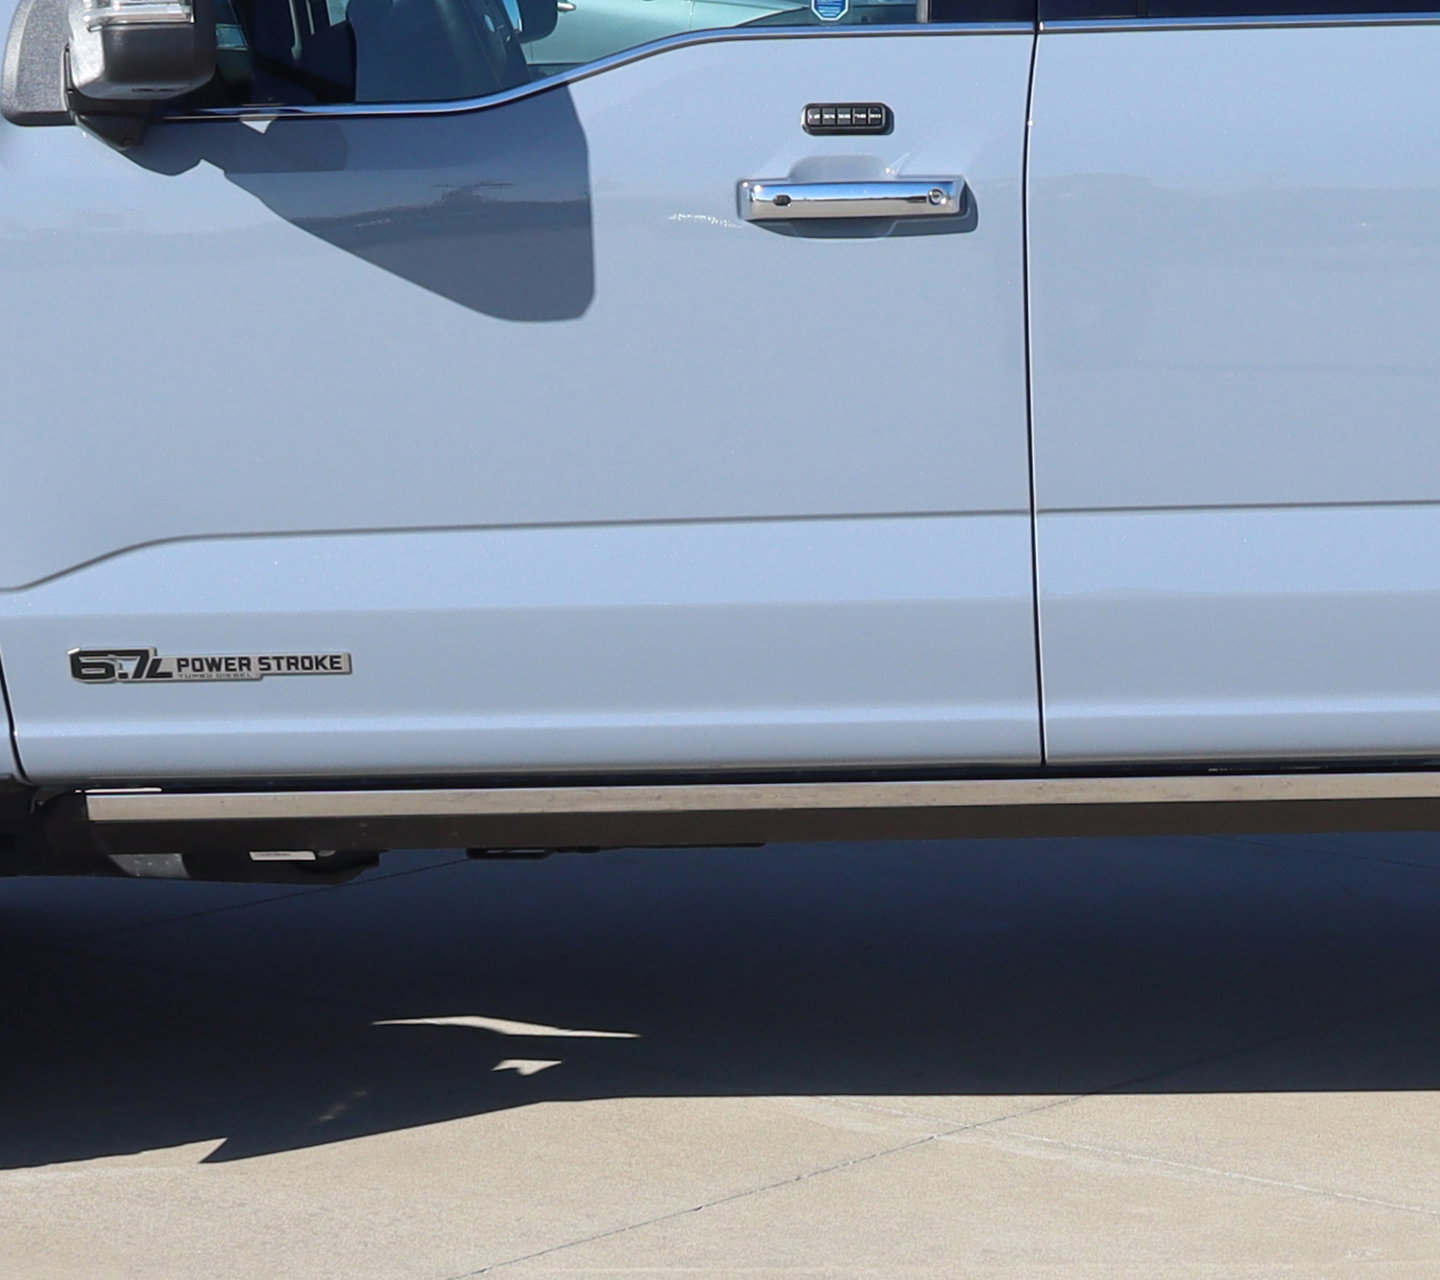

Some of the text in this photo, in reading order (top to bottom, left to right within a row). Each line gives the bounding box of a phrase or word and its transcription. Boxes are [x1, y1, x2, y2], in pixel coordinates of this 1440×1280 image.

[68, 649, 343, 681] 6.7L POWER STROKE
